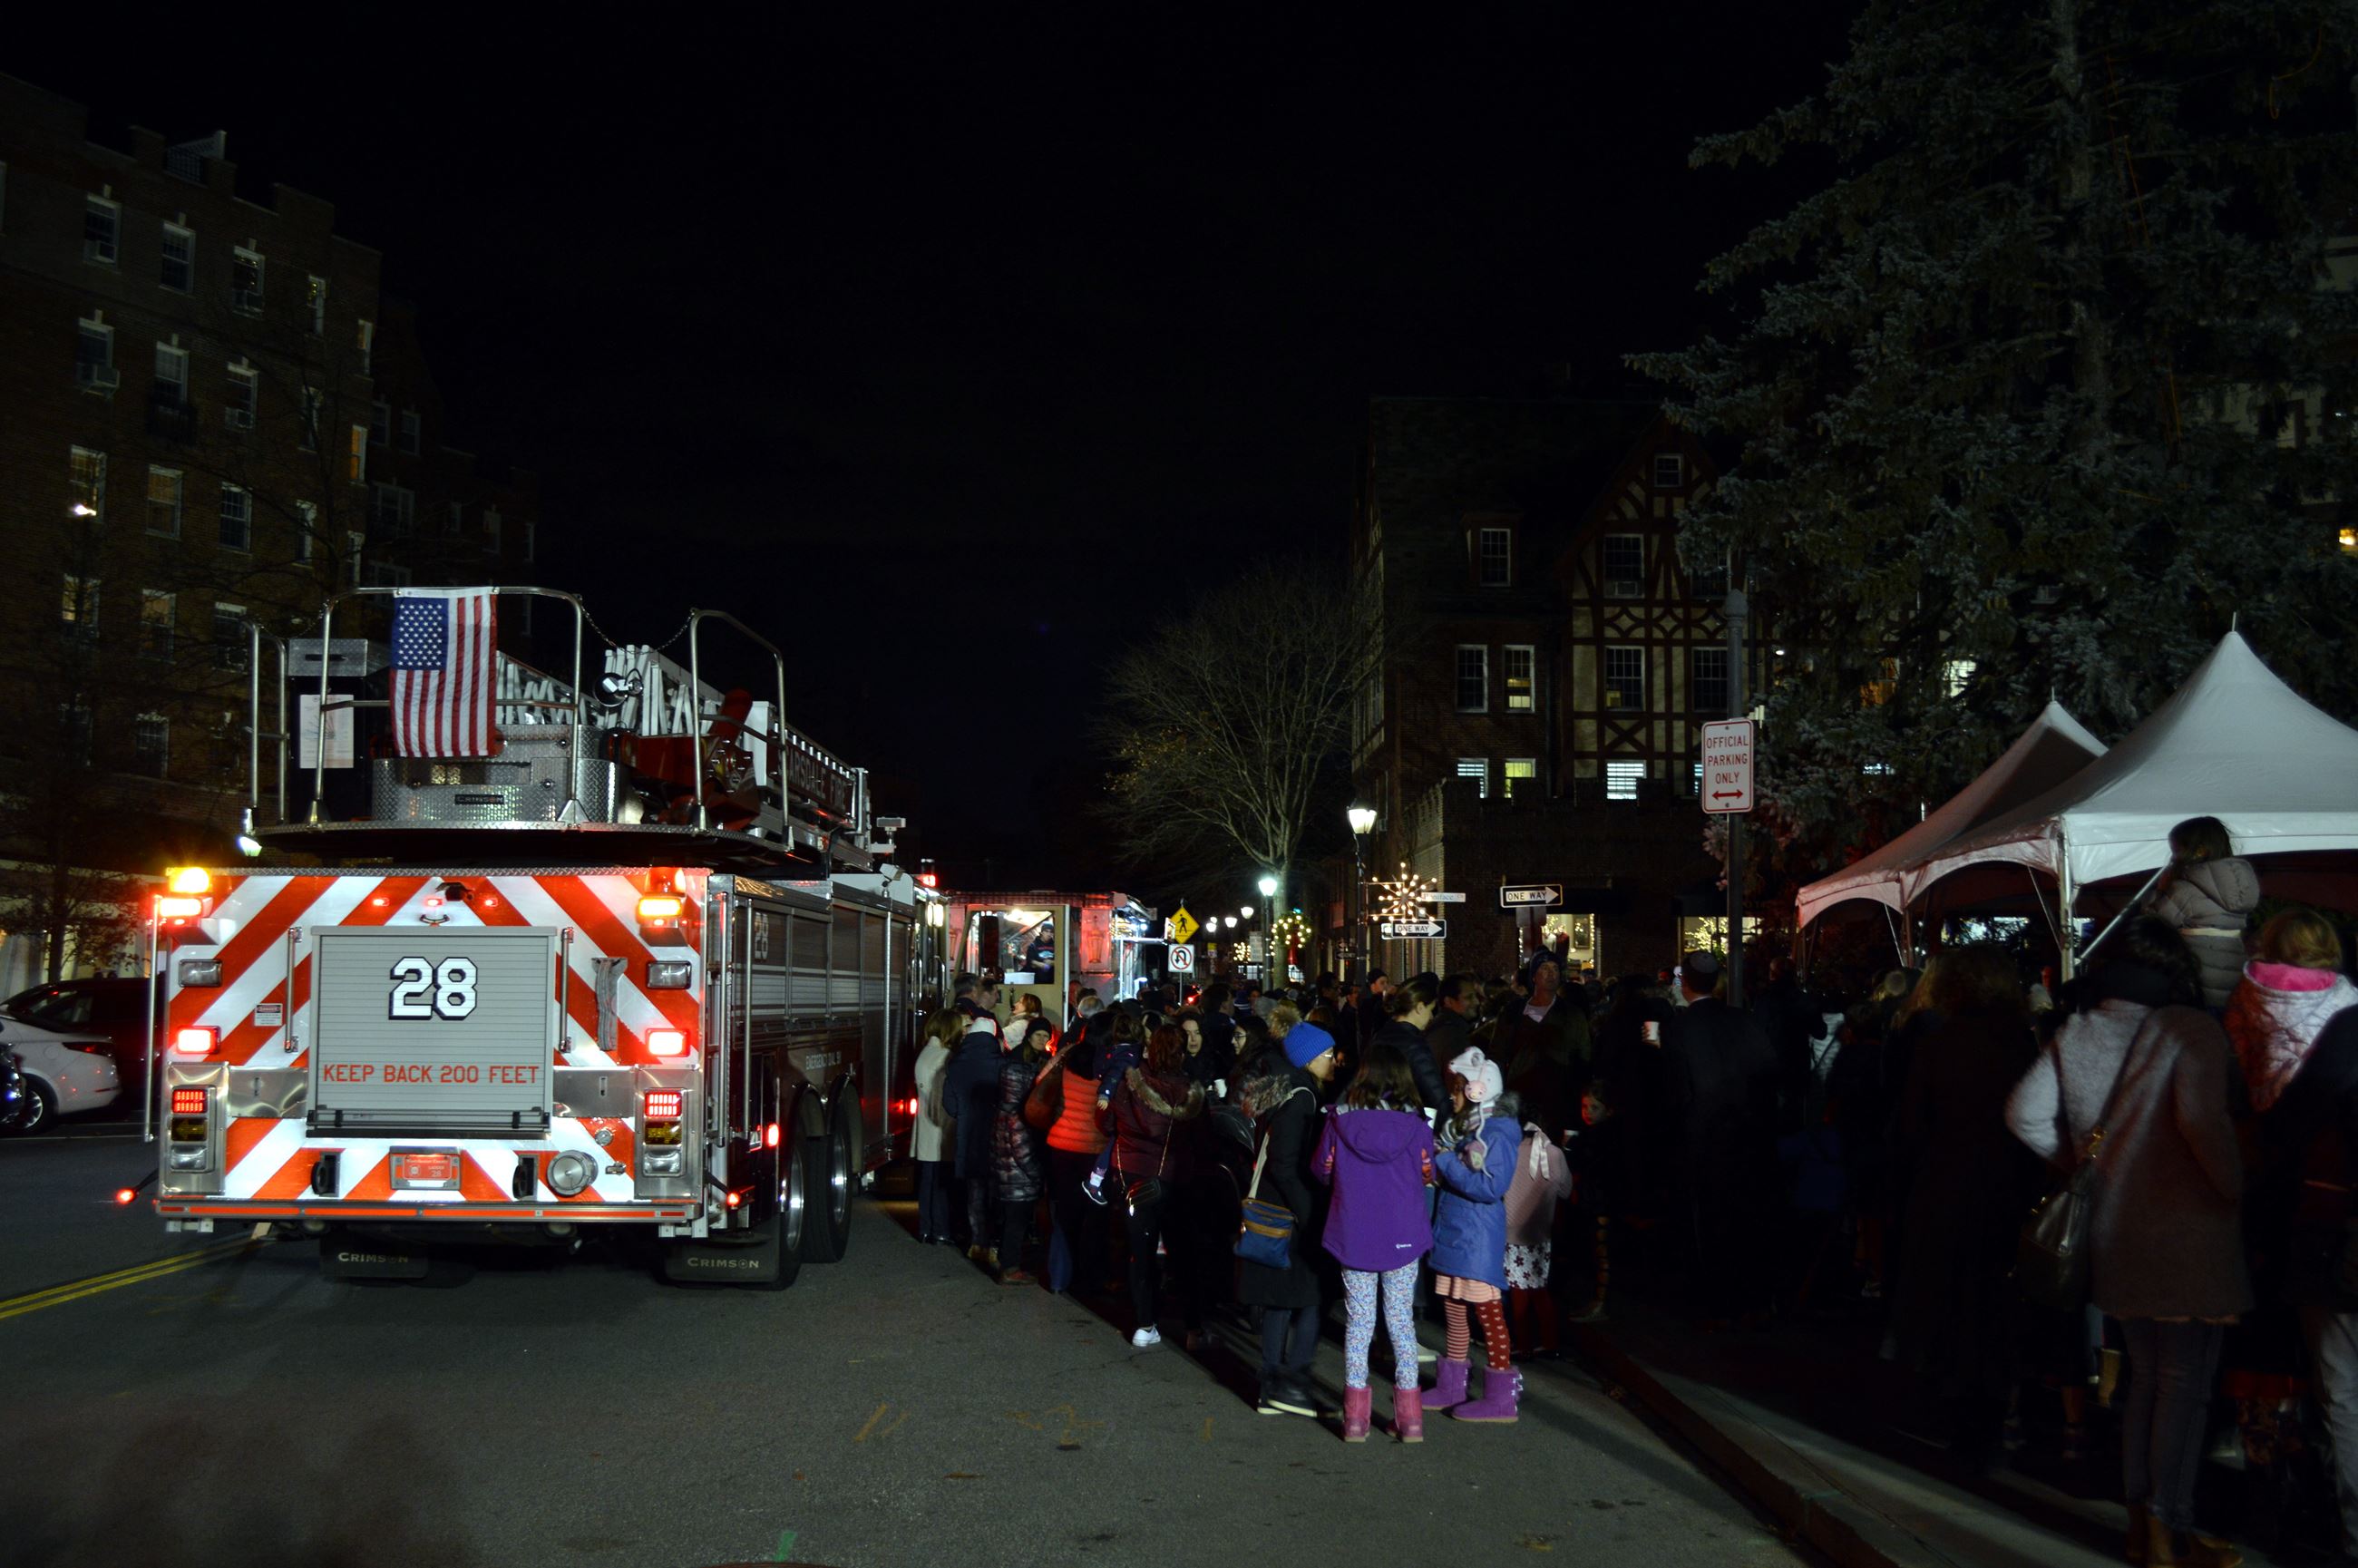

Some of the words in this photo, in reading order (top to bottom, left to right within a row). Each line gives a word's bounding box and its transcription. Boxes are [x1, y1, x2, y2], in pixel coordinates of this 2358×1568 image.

[1706, 735, 1749, 749] OFFICIAL
[1707, 753, 1748, 766] PARKING
[1715, 772, 1740, 784] ONLY
[1507, 891, 1525, 901] ONE
[1529, 891, 1547, 900] WAY
[388, 956, 478, 1020] 28
[323, 1064, 375, 1082] KEEP
[384, 1065, 433, 1083] BACK
[440, 1066, 479, 1083] 200
[489, 1066, 539, 1084] FEET
[337, 1251, 408, 1263] CRIMSON
[687, 1257, 760, 1269] CRIMSON
